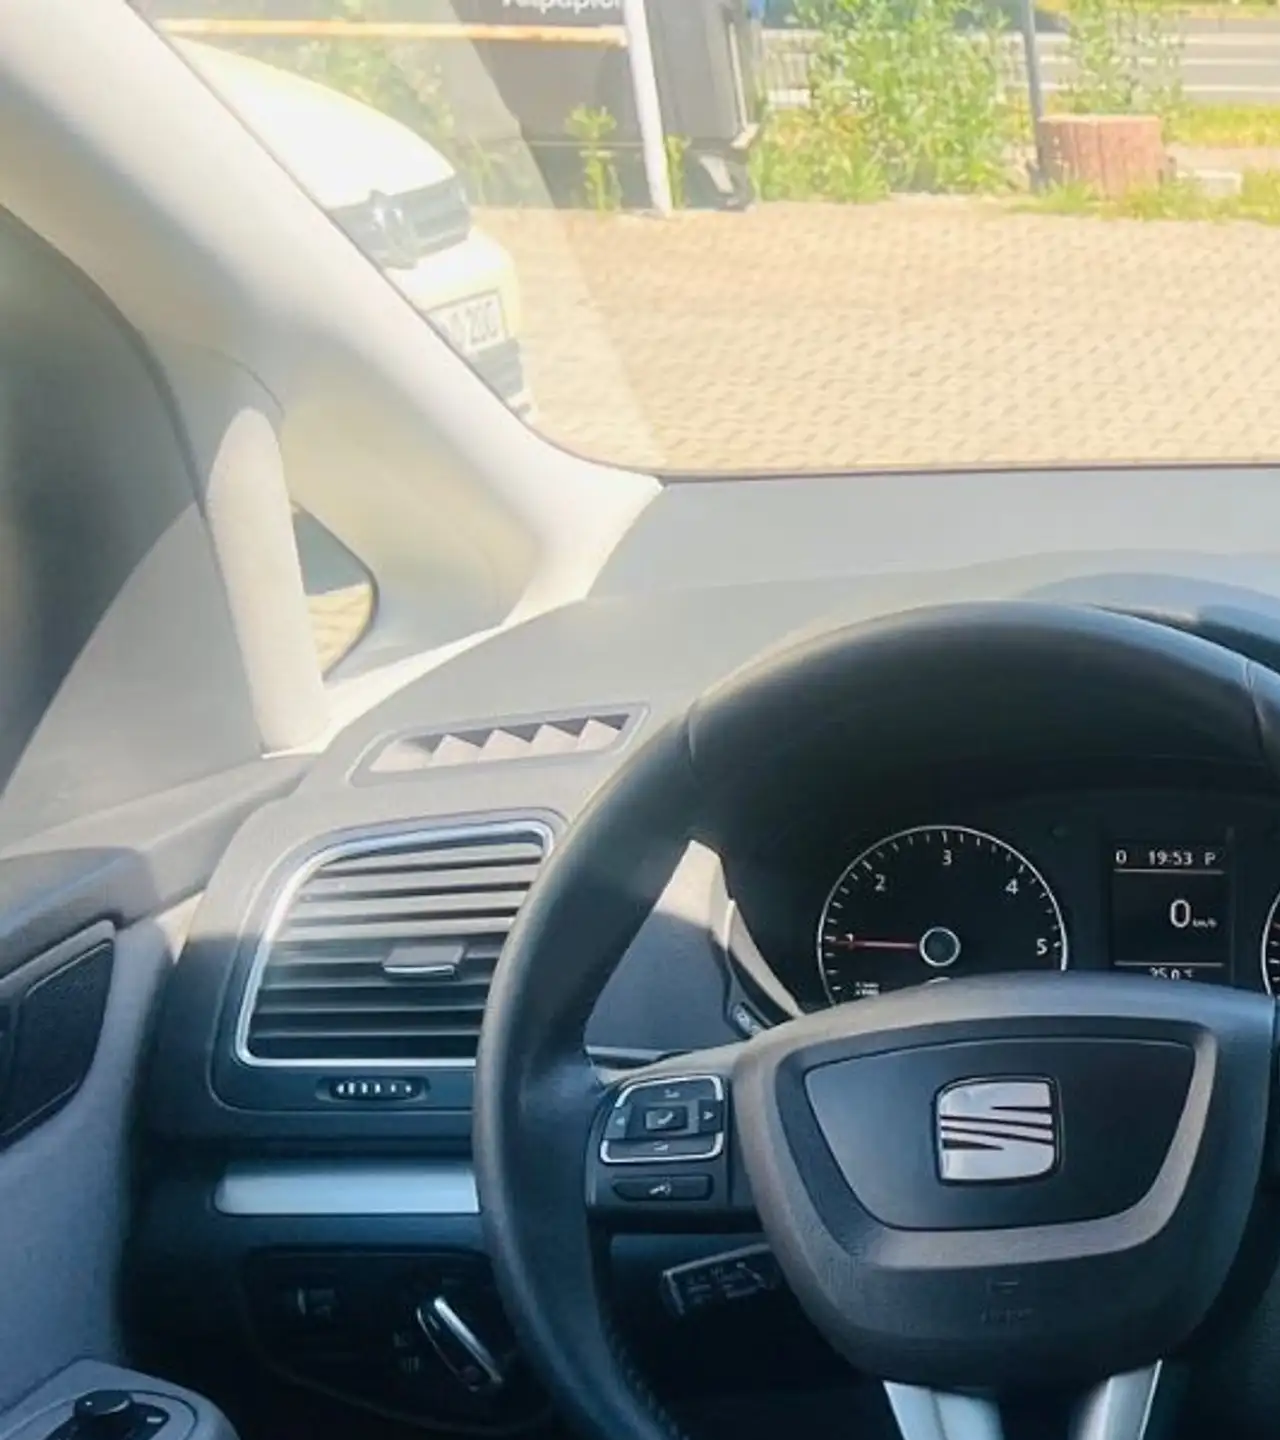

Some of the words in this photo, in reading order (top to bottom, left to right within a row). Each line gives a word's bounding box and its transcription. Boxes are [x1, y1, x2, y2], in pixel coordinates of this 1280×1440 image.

[942, 850, 953, 866] 3
[875, 874, 886, 892] 2
[1005, 879, 1019, 895] 4
[1170, 899, 1191, 928] 0
[1036, 939, 1048, 955] 5
